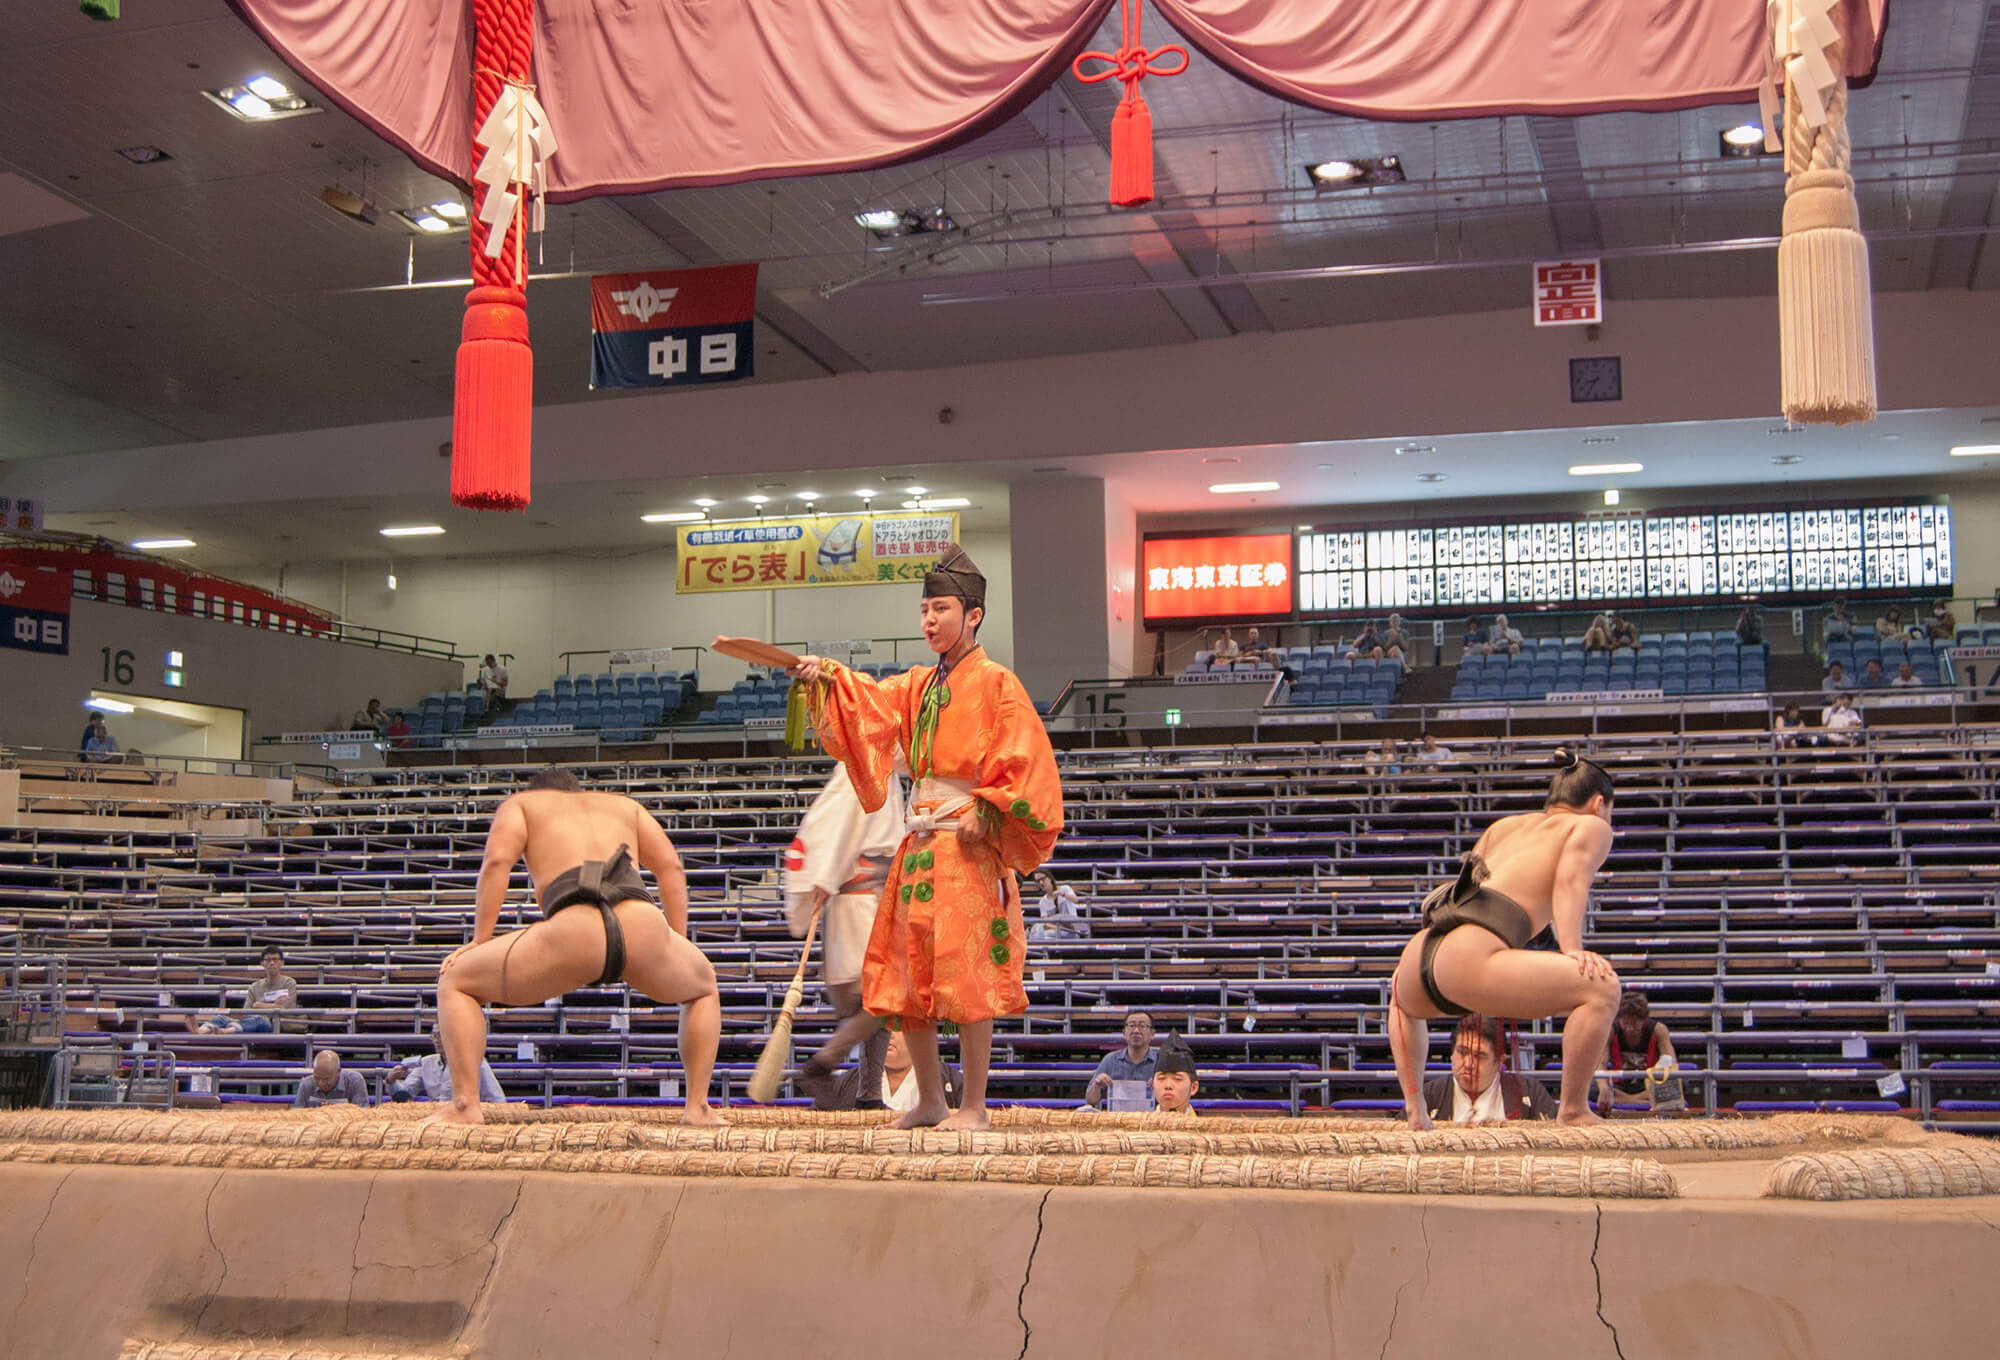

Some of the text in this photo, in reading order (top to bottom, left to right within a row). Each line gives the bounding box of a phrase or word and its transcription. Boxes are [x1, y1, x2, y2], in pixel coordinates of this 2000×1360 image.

[648, 334, 737, 378] 中日
[875, 529, 949, 542] ドアラとシャオロンの
[875, 540, 951, 556] 置き畳 販売中
[684, 551, 807, 586] 「でら表」
[1148, 561, 1288, 592] 東海東京証券
[14, 615, 63, 645] 中日
[101, 646, 136, 686] 16
[1085, 692, 1128, 728] 15
